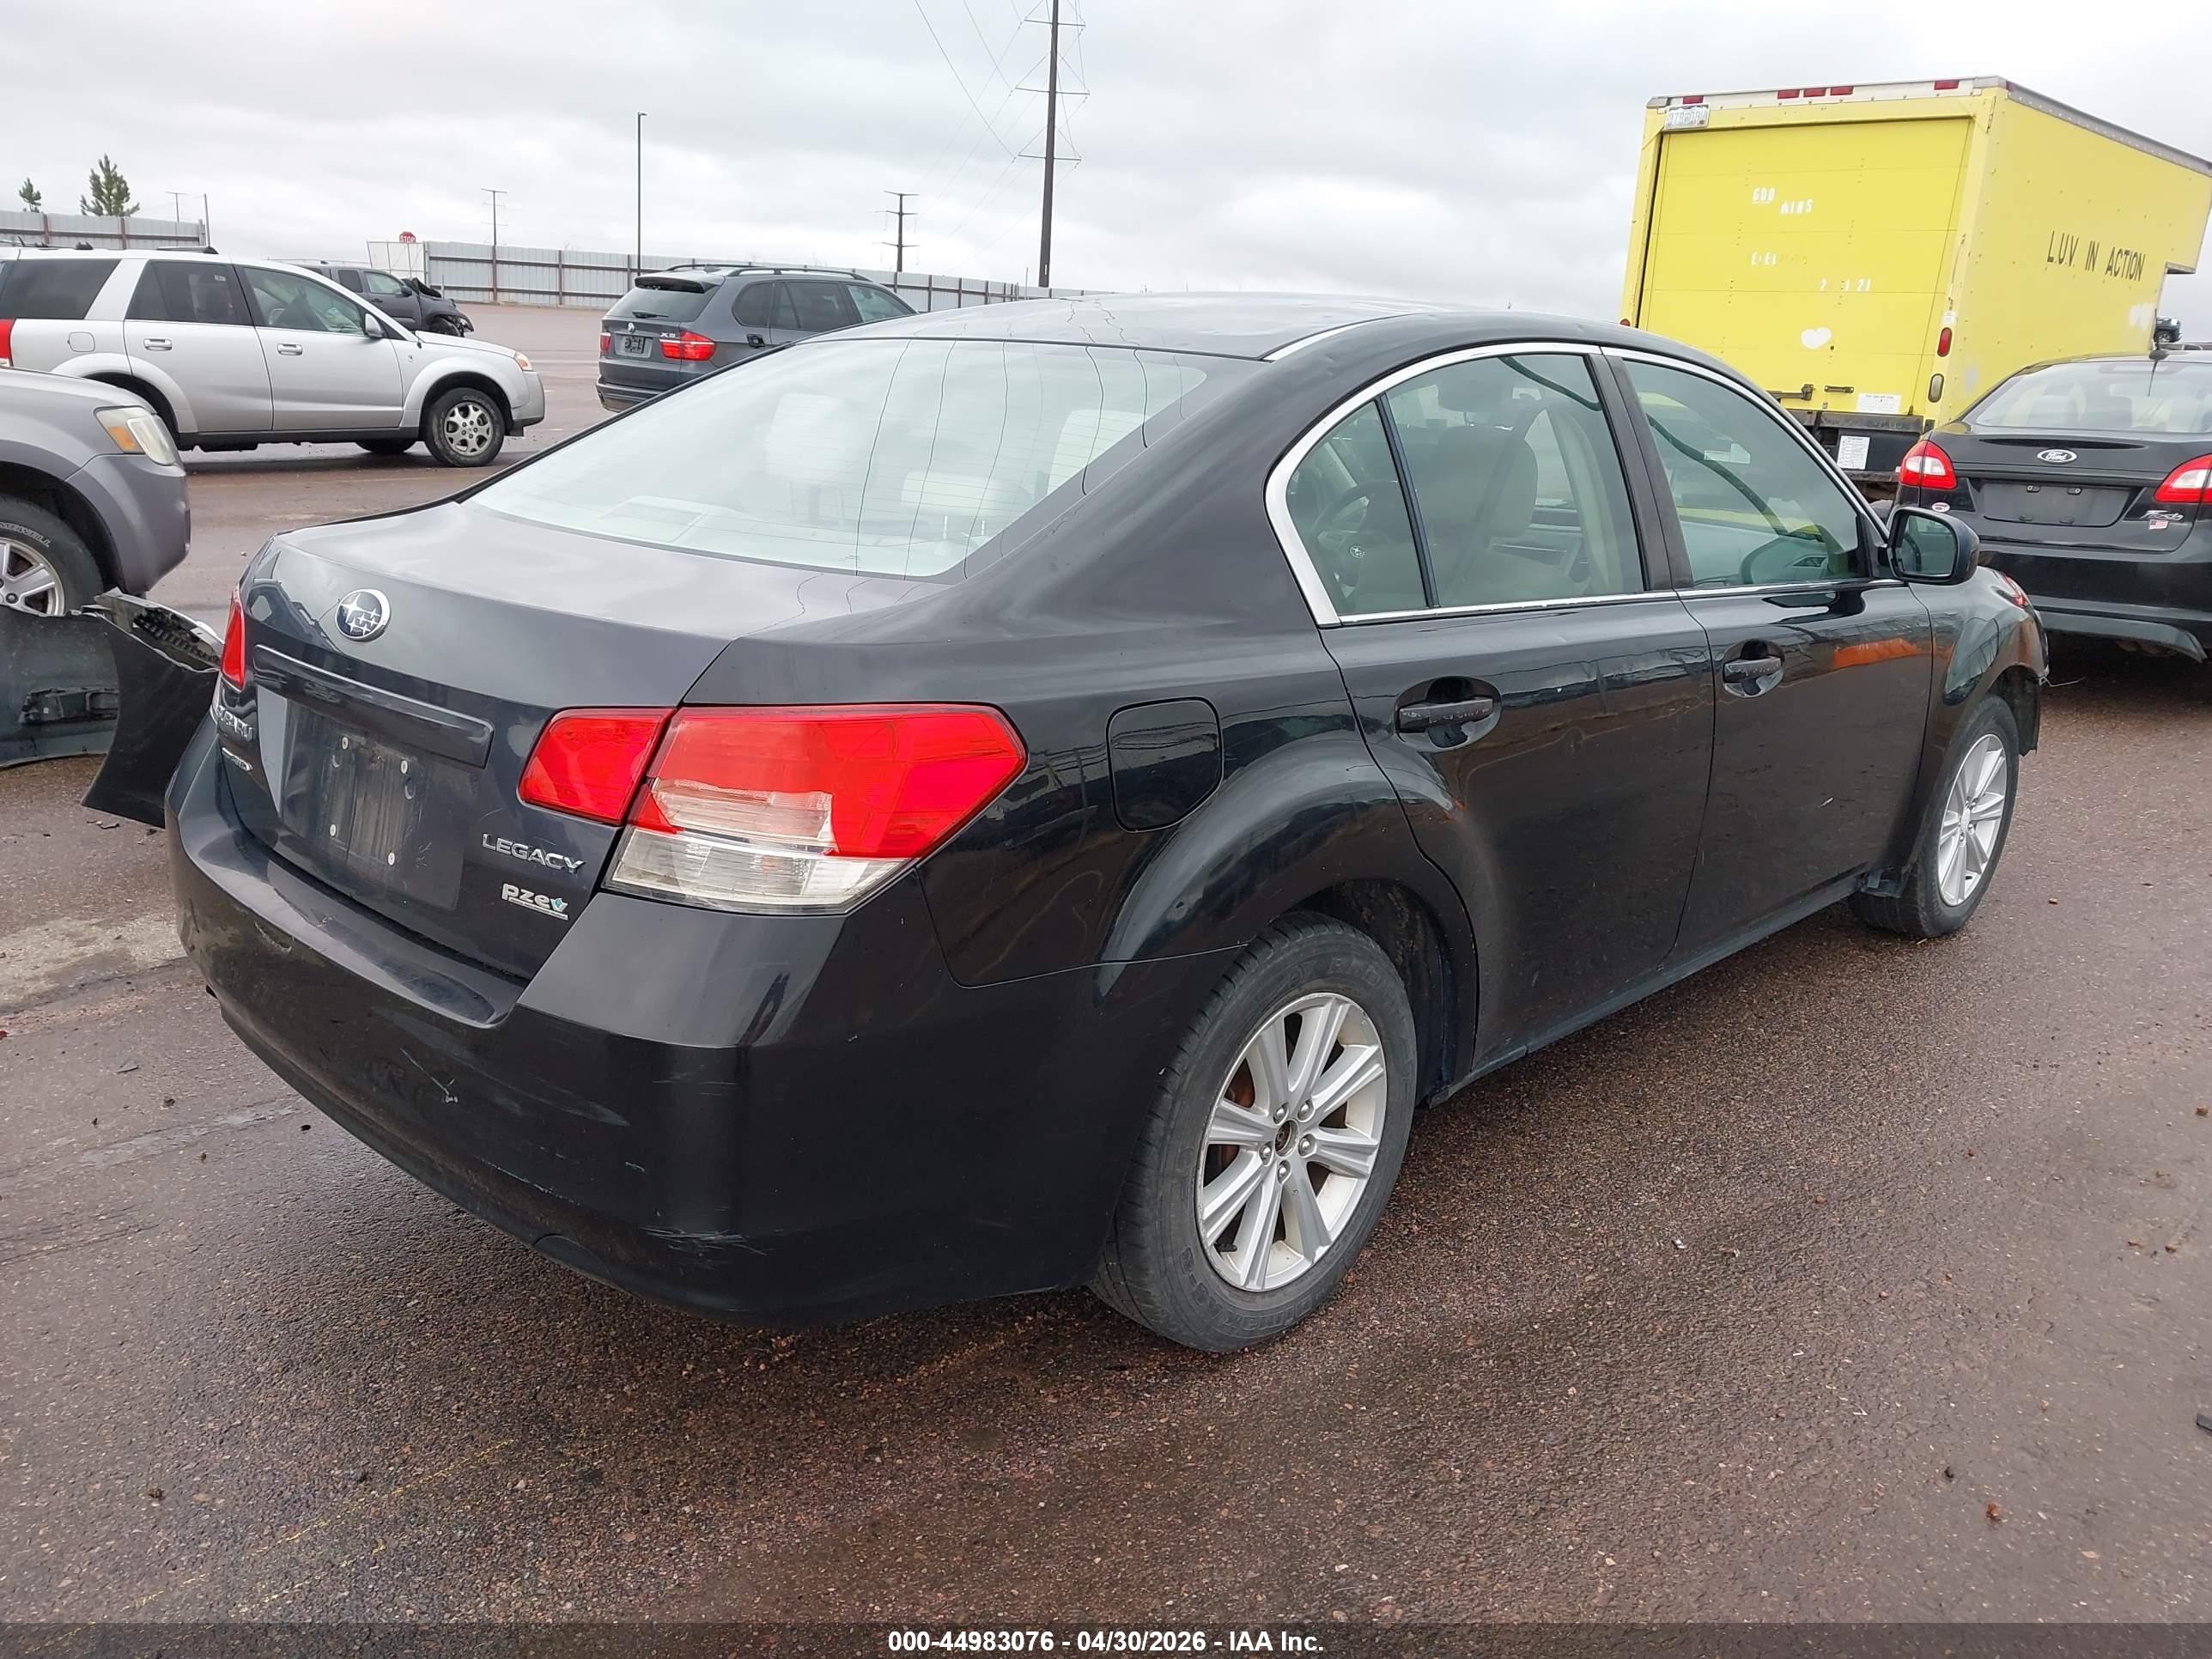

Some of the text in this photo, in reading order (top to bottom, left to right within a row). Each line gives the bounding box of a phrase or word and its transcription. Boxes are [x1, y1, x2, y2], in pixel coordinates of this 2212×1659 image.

[399, 235, 416, 244] STOP
[2085, 240, 2100, 273] IN
[2105, 246, 2146, 283] ACTION
[2042, 450, 2071, 461] Ford
[216, 704, 255, 742] SUBARU
[482, 833, 586, 874] LEGACY
